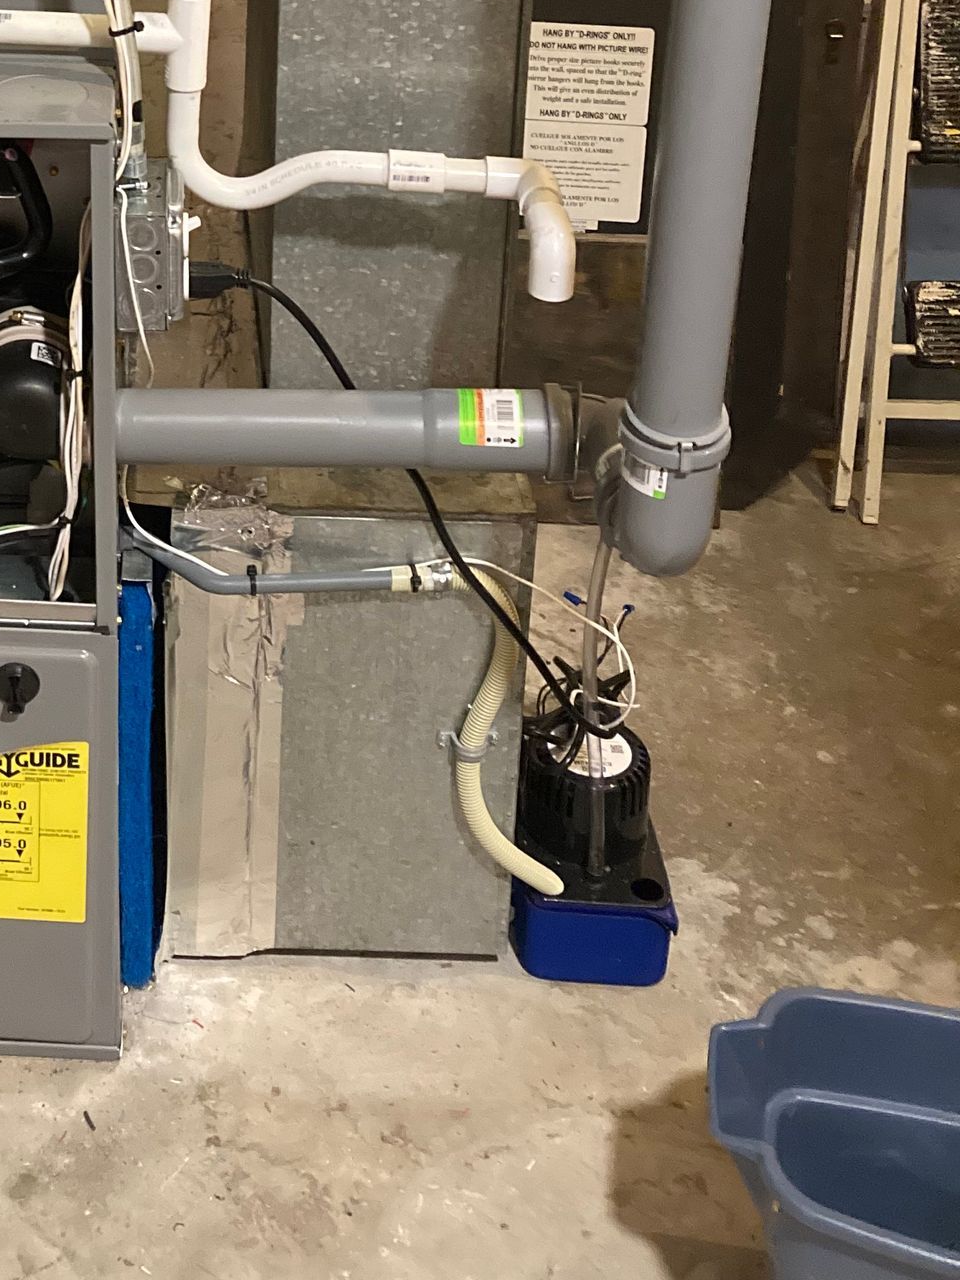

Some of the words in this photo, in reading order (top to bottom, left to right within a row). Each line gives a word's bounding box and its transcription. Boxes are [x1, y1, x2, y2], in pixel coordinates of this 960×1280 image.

[543, 28, 563, 37] HANG
[530, 40, 540, 48] DO
[541, 42, 556, 50] NOT
[597, 45, 627, 53] PICTURE
[547, 76, 571, 84] hangers
[584, 77, 599, 85] hang
[560, 86, 571, 94] give
[596, 88, 631, 96] distribution
[540, 108, 560, 117] HANG
[608, 112, 628, 120] ONLY
